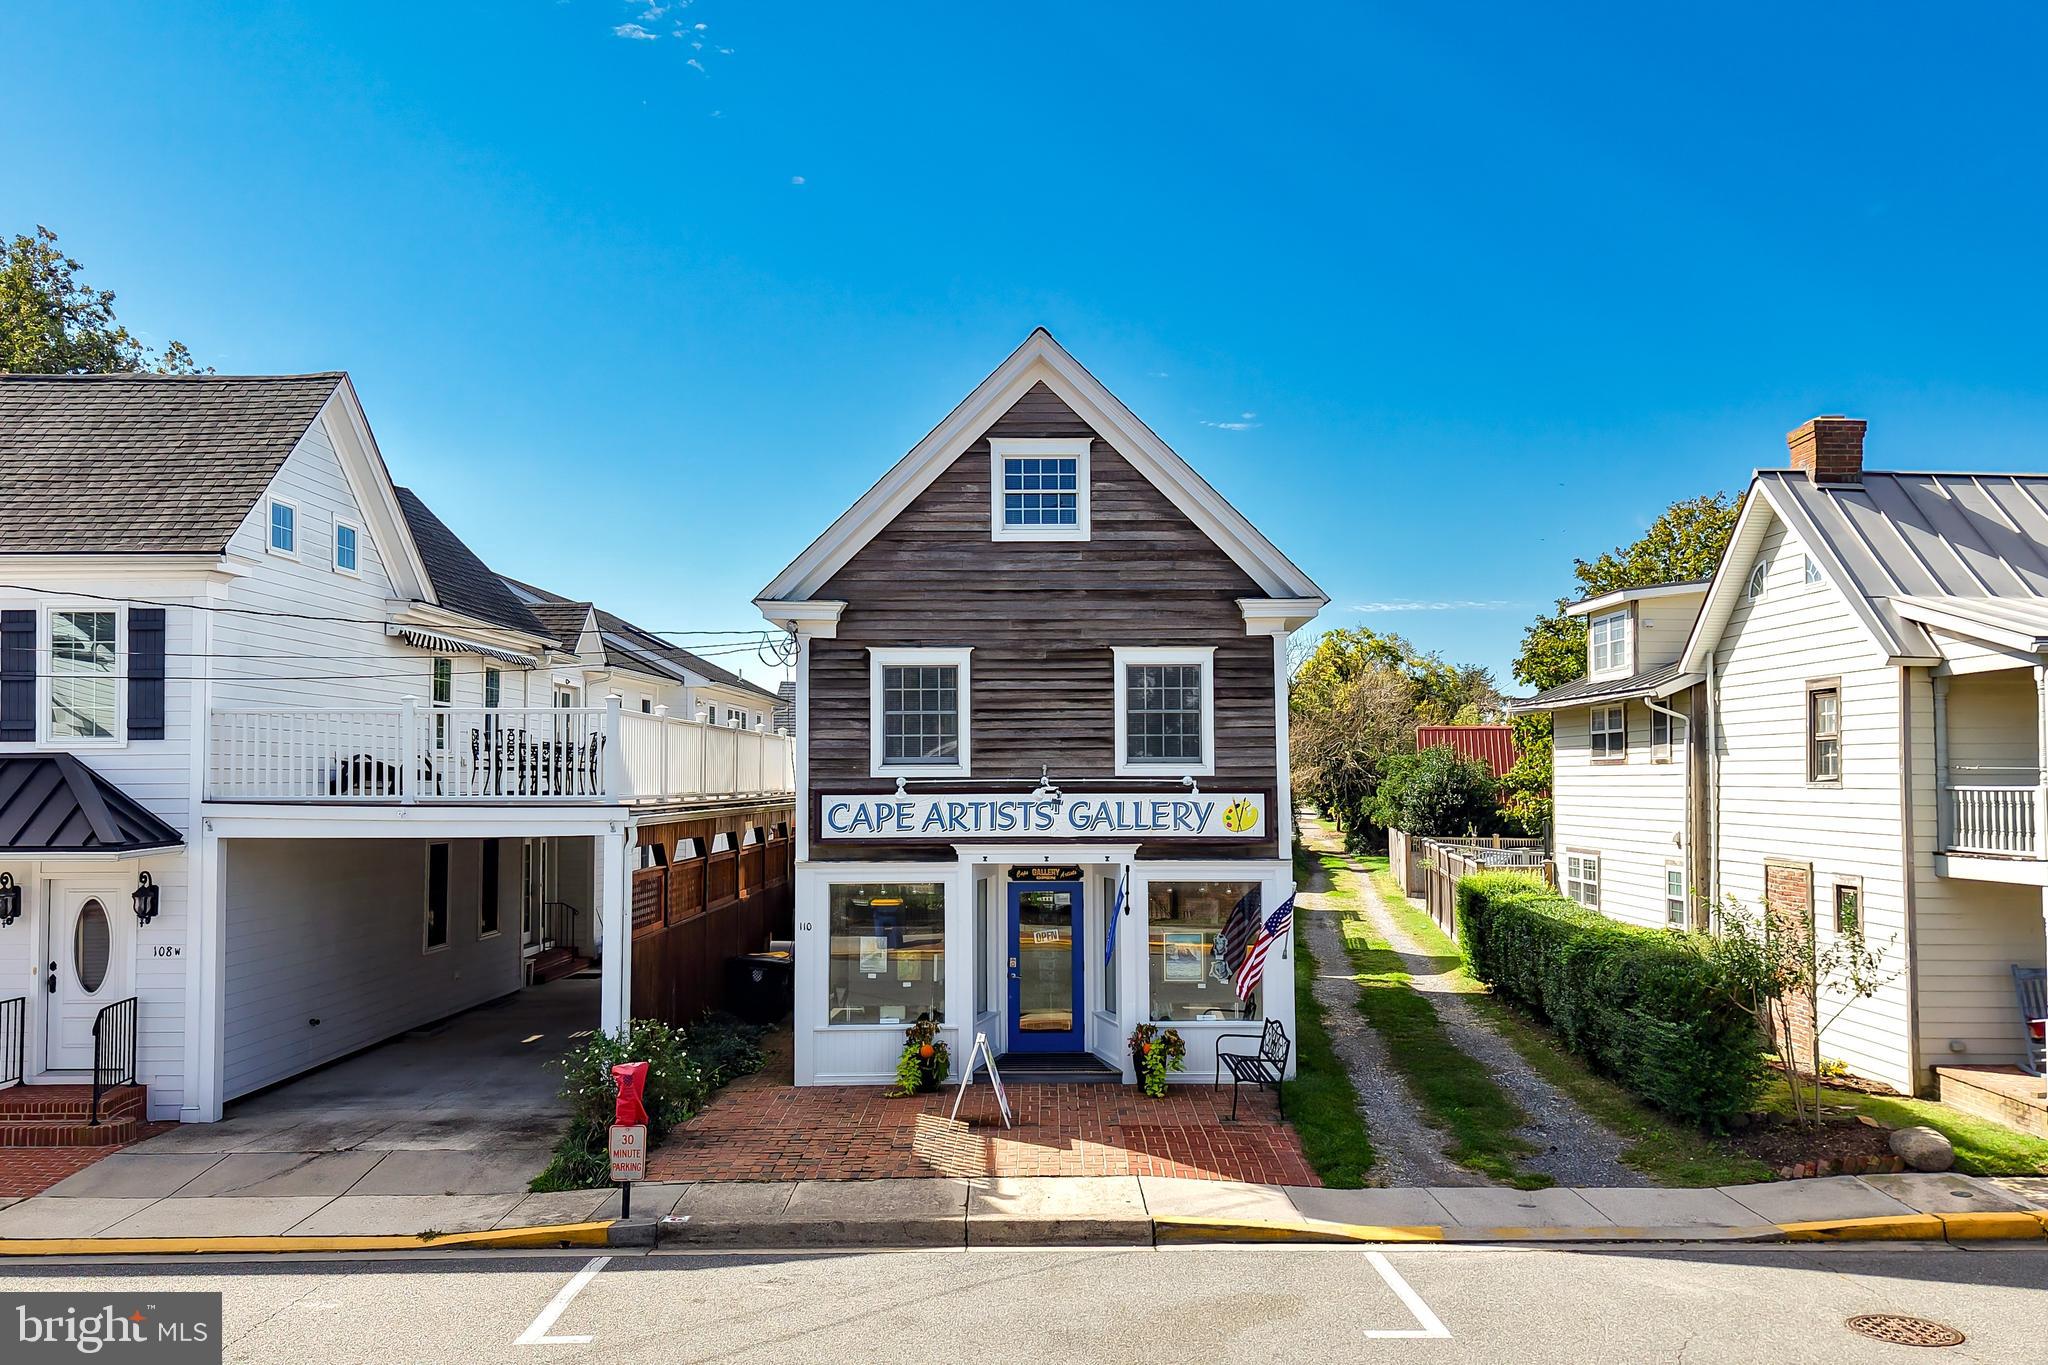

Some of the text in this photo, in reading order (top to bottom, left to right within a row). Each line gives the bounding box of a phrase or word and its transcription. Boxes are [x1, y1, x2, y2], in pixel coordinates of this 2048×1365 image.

[827, 801, 915, 833] CAPE
[1068, 800, 1215, 834] GALLERY
[1031, 868, 1060, 876] GALLERY
[799, 922, 812, 931] 110
[1036, 930, 1058, 942] OPEN
[621, 1134, 635, 1145] 30
[613, 1149, 641, 1158] MINUTE
[612, 1162, 642, 1172] PARKING
